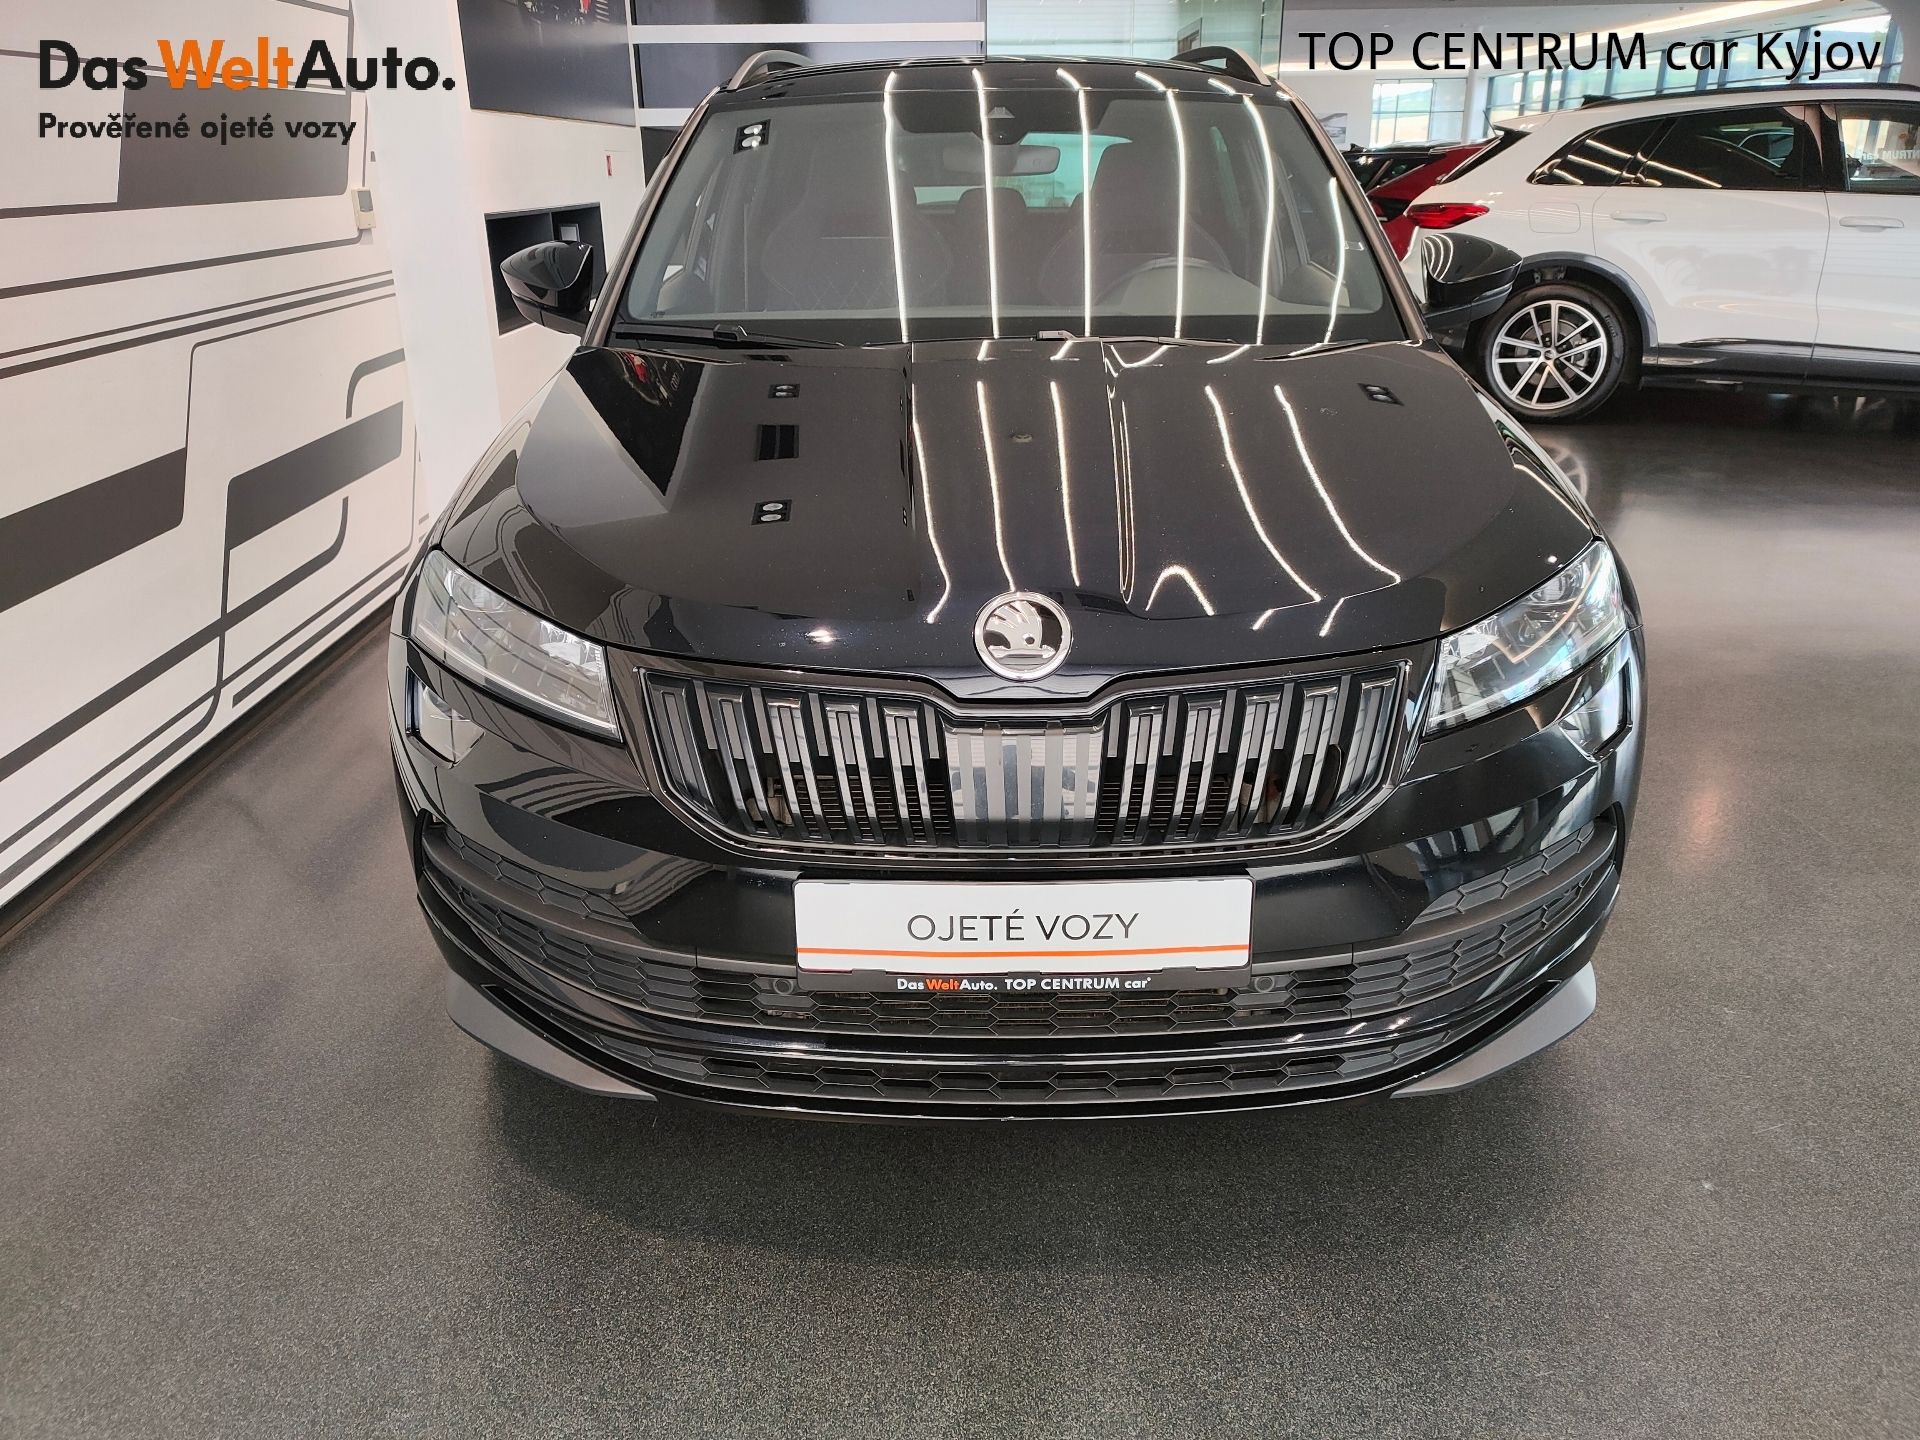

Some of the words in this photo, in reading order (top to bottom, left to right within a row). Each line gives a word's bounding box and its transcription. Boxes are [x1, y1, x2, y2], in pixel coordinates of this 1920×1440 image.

[907, 909, 1025, 941] OJETÉ
[1036, 912, 1139, 940] VOZY
[897, 978, 925, 990] Das
[926, 978, 998, 991] WeltAuto.
[1005, 978, 1036, 990] TOP
[1041, 977, 1120, 990] CENTRUM
